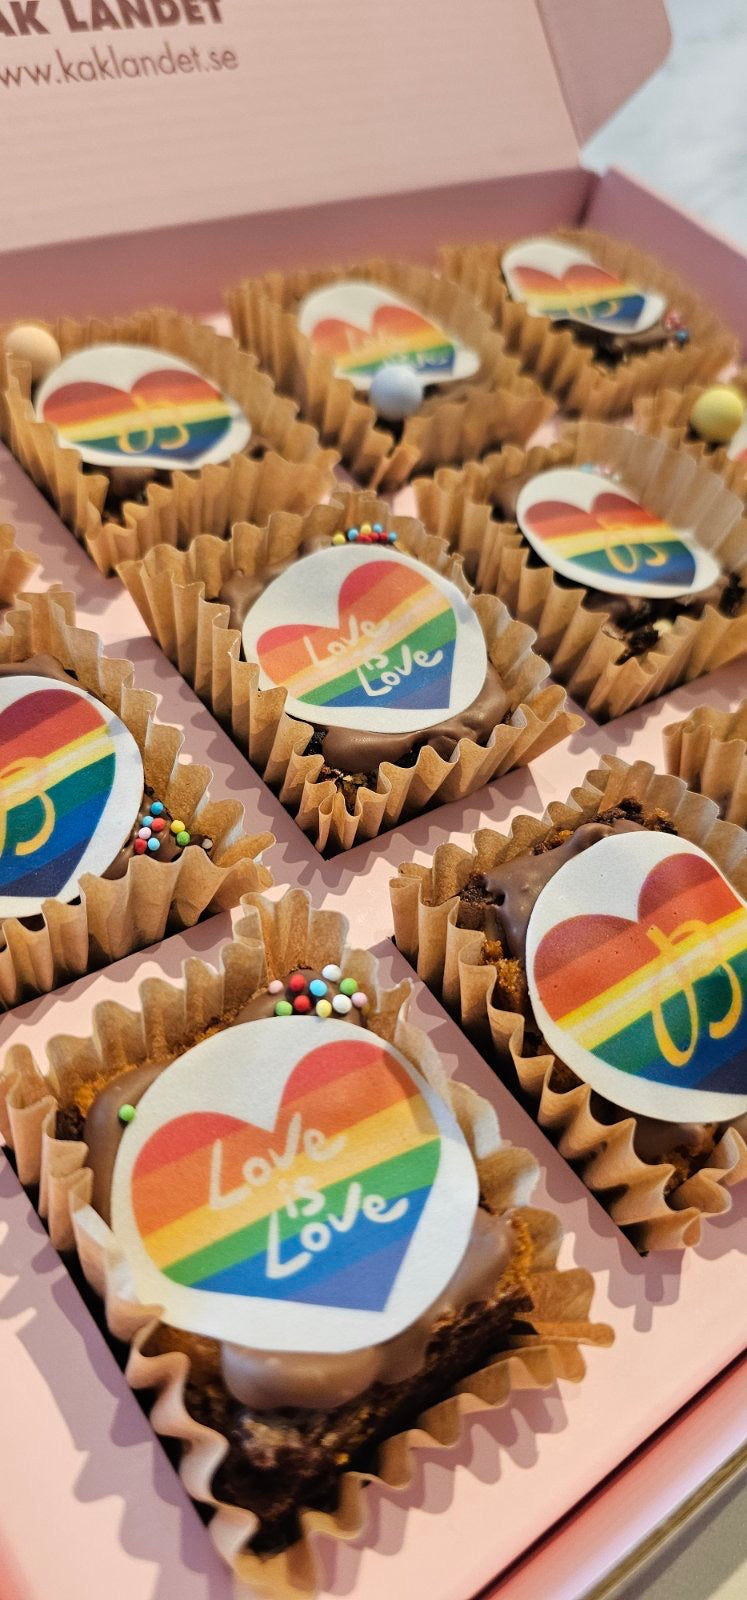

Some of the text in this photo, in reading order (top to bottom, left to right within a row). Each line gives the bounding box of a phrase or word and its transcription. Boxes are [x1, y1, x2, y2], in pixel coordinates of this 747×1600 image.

[60, 0, 223, 33] LANDET
[302, 614, 390, 669] Love
[357, 645, 389, 671] is
[356, 644, 443, 697] Love
[208, 1111, 347, 1211] Love
[276, 1175, 326, 1219] is
[265, 1182, 410, 1280] Love
